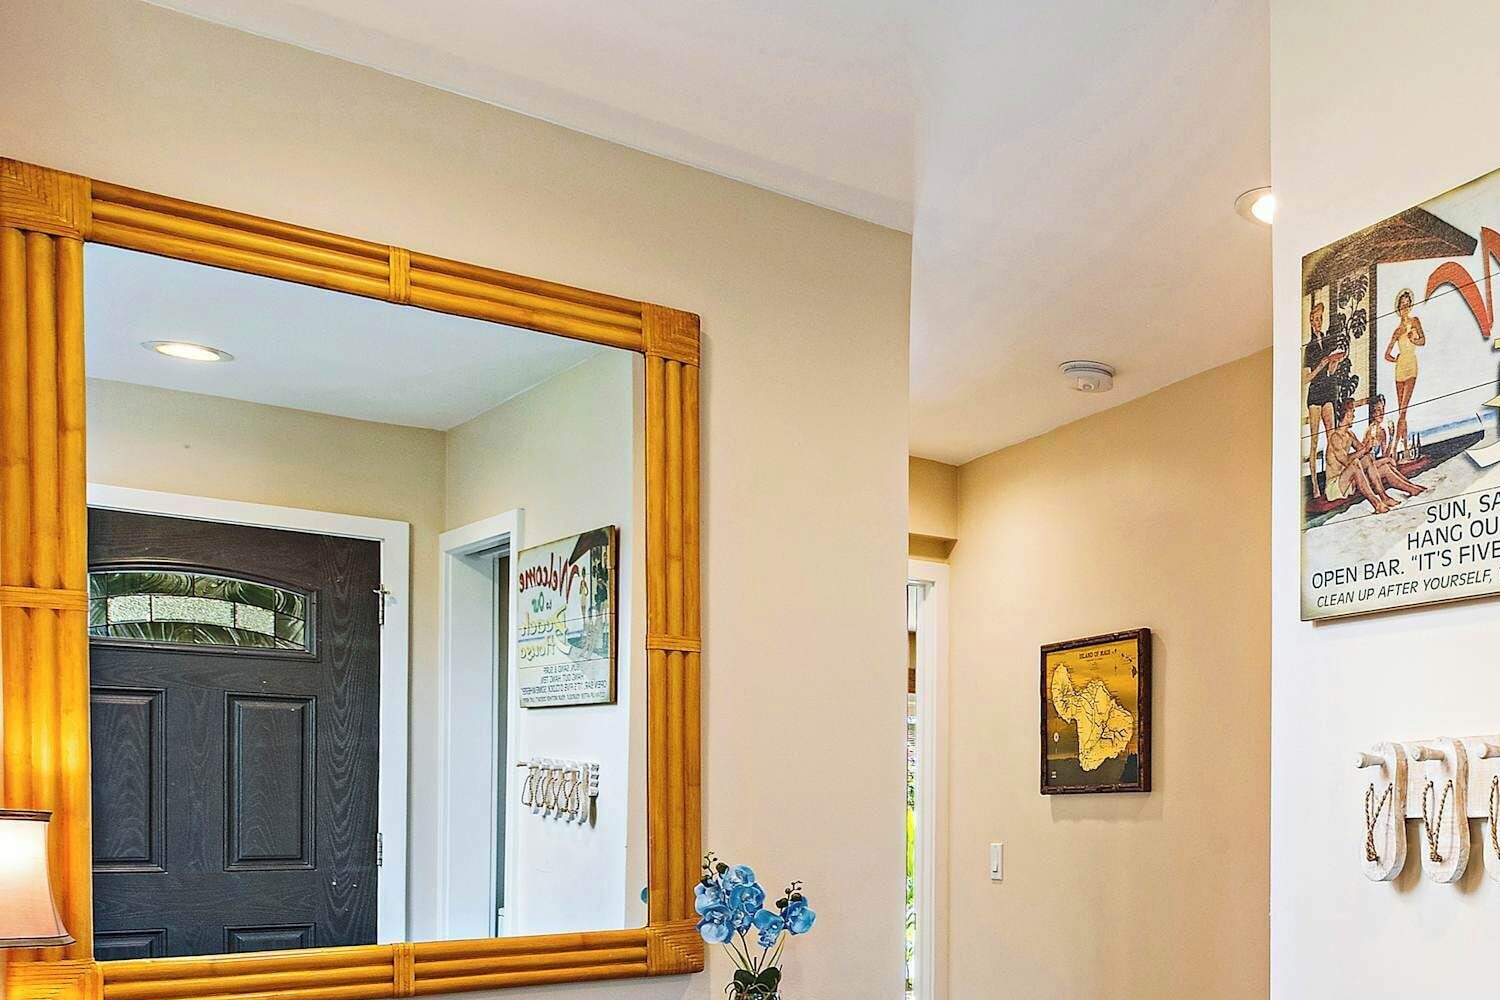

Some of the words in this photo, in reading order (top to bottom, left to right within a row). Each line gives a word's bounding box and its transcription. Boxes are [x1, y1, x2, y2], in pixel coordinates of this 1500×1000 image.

[1426, 499, 1472, 524] SUN,
[1407, 524, 1463, 550] HANG
[1312, 566, 1357, 589] OPEN
[1363, 558, 1405, 580] BAR.
[1317, 590, 1354, 608] CLEAN
[1358, 586, 1375, 602] UP
[1378, 581, 1418, 599] AFTER
[1423, 568, 1492, 592] YOURSELF,
